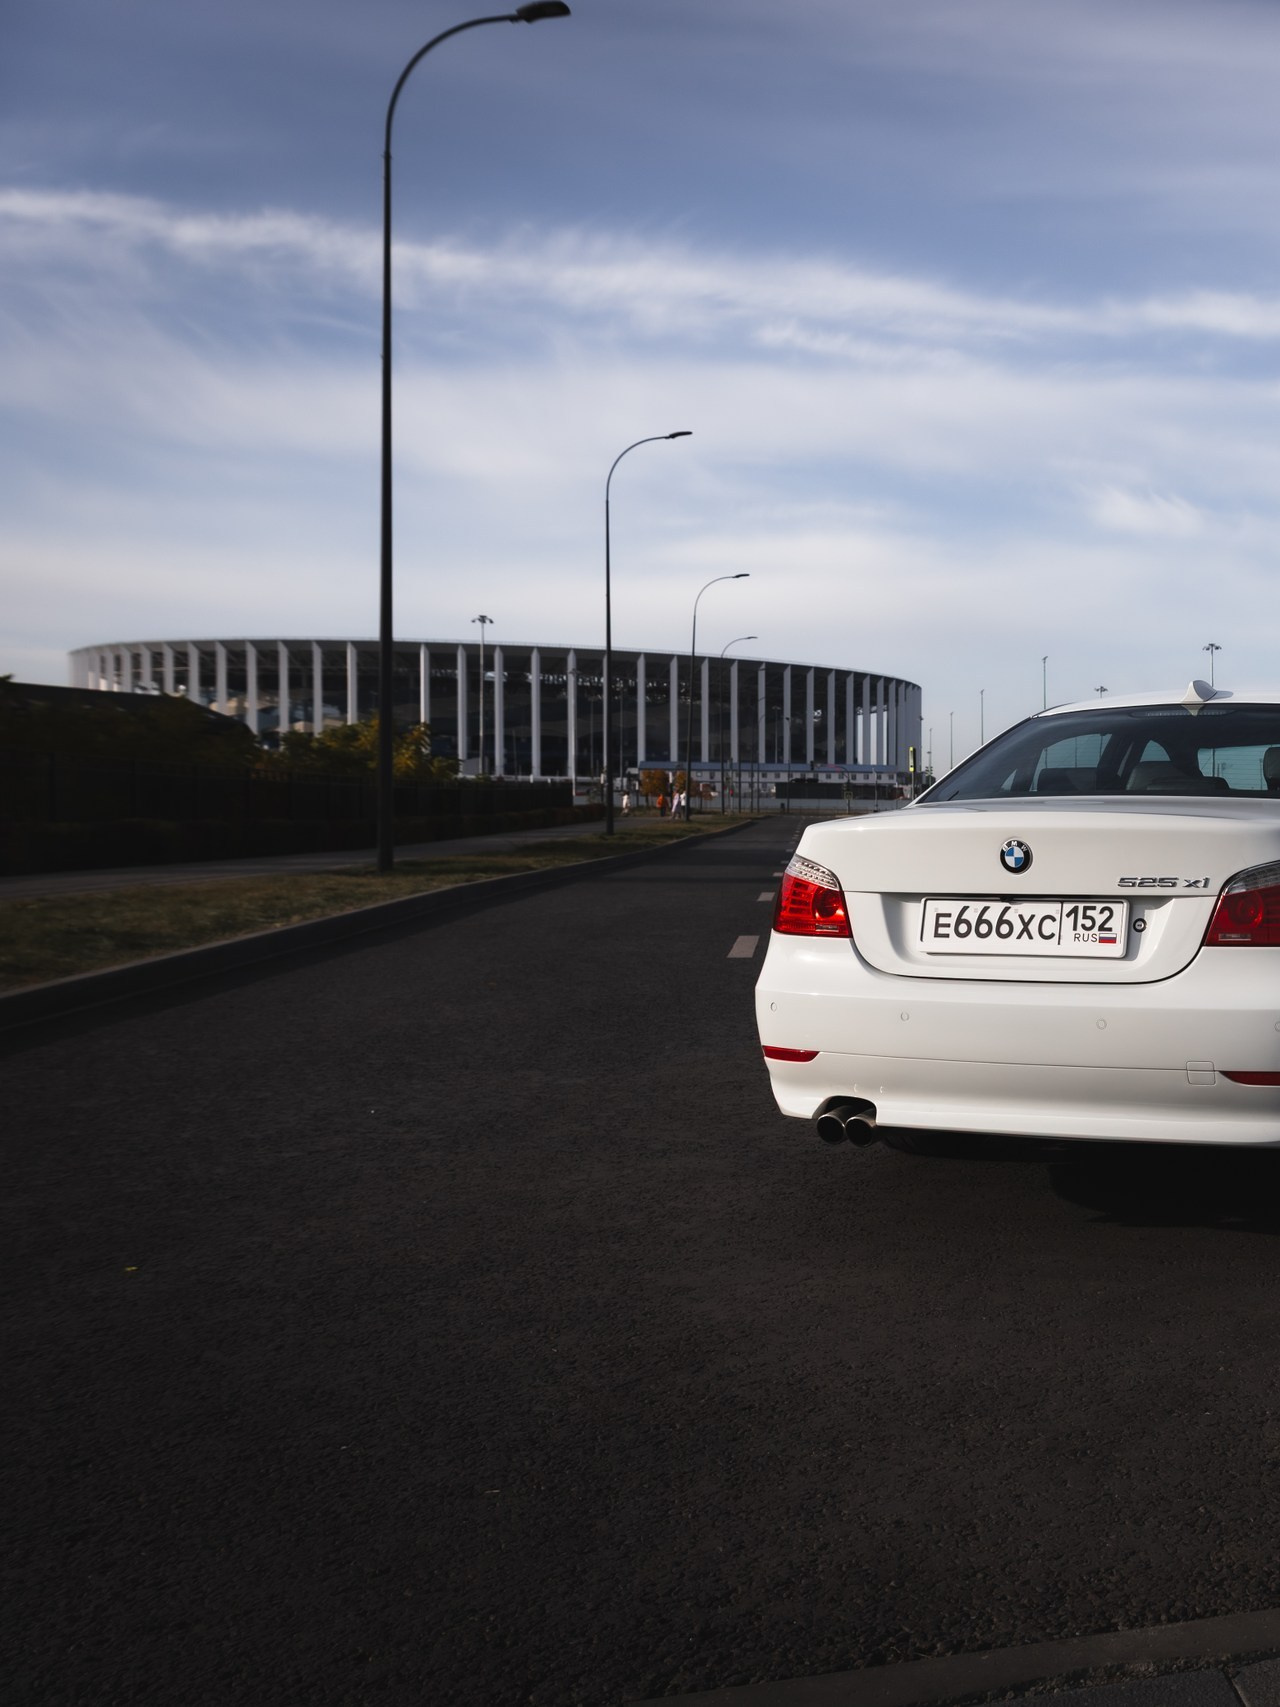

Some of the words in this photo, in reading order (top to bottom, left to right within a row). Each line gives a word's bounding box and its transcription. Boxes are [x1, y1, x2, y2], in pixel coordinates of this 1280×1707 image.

[1117, 877, 1179, 888] 525
[933, 905, 1057, 940] E666XC
[1065, 905, 1114, 932] 152
[1073, 932, 1098, 943] RUS
